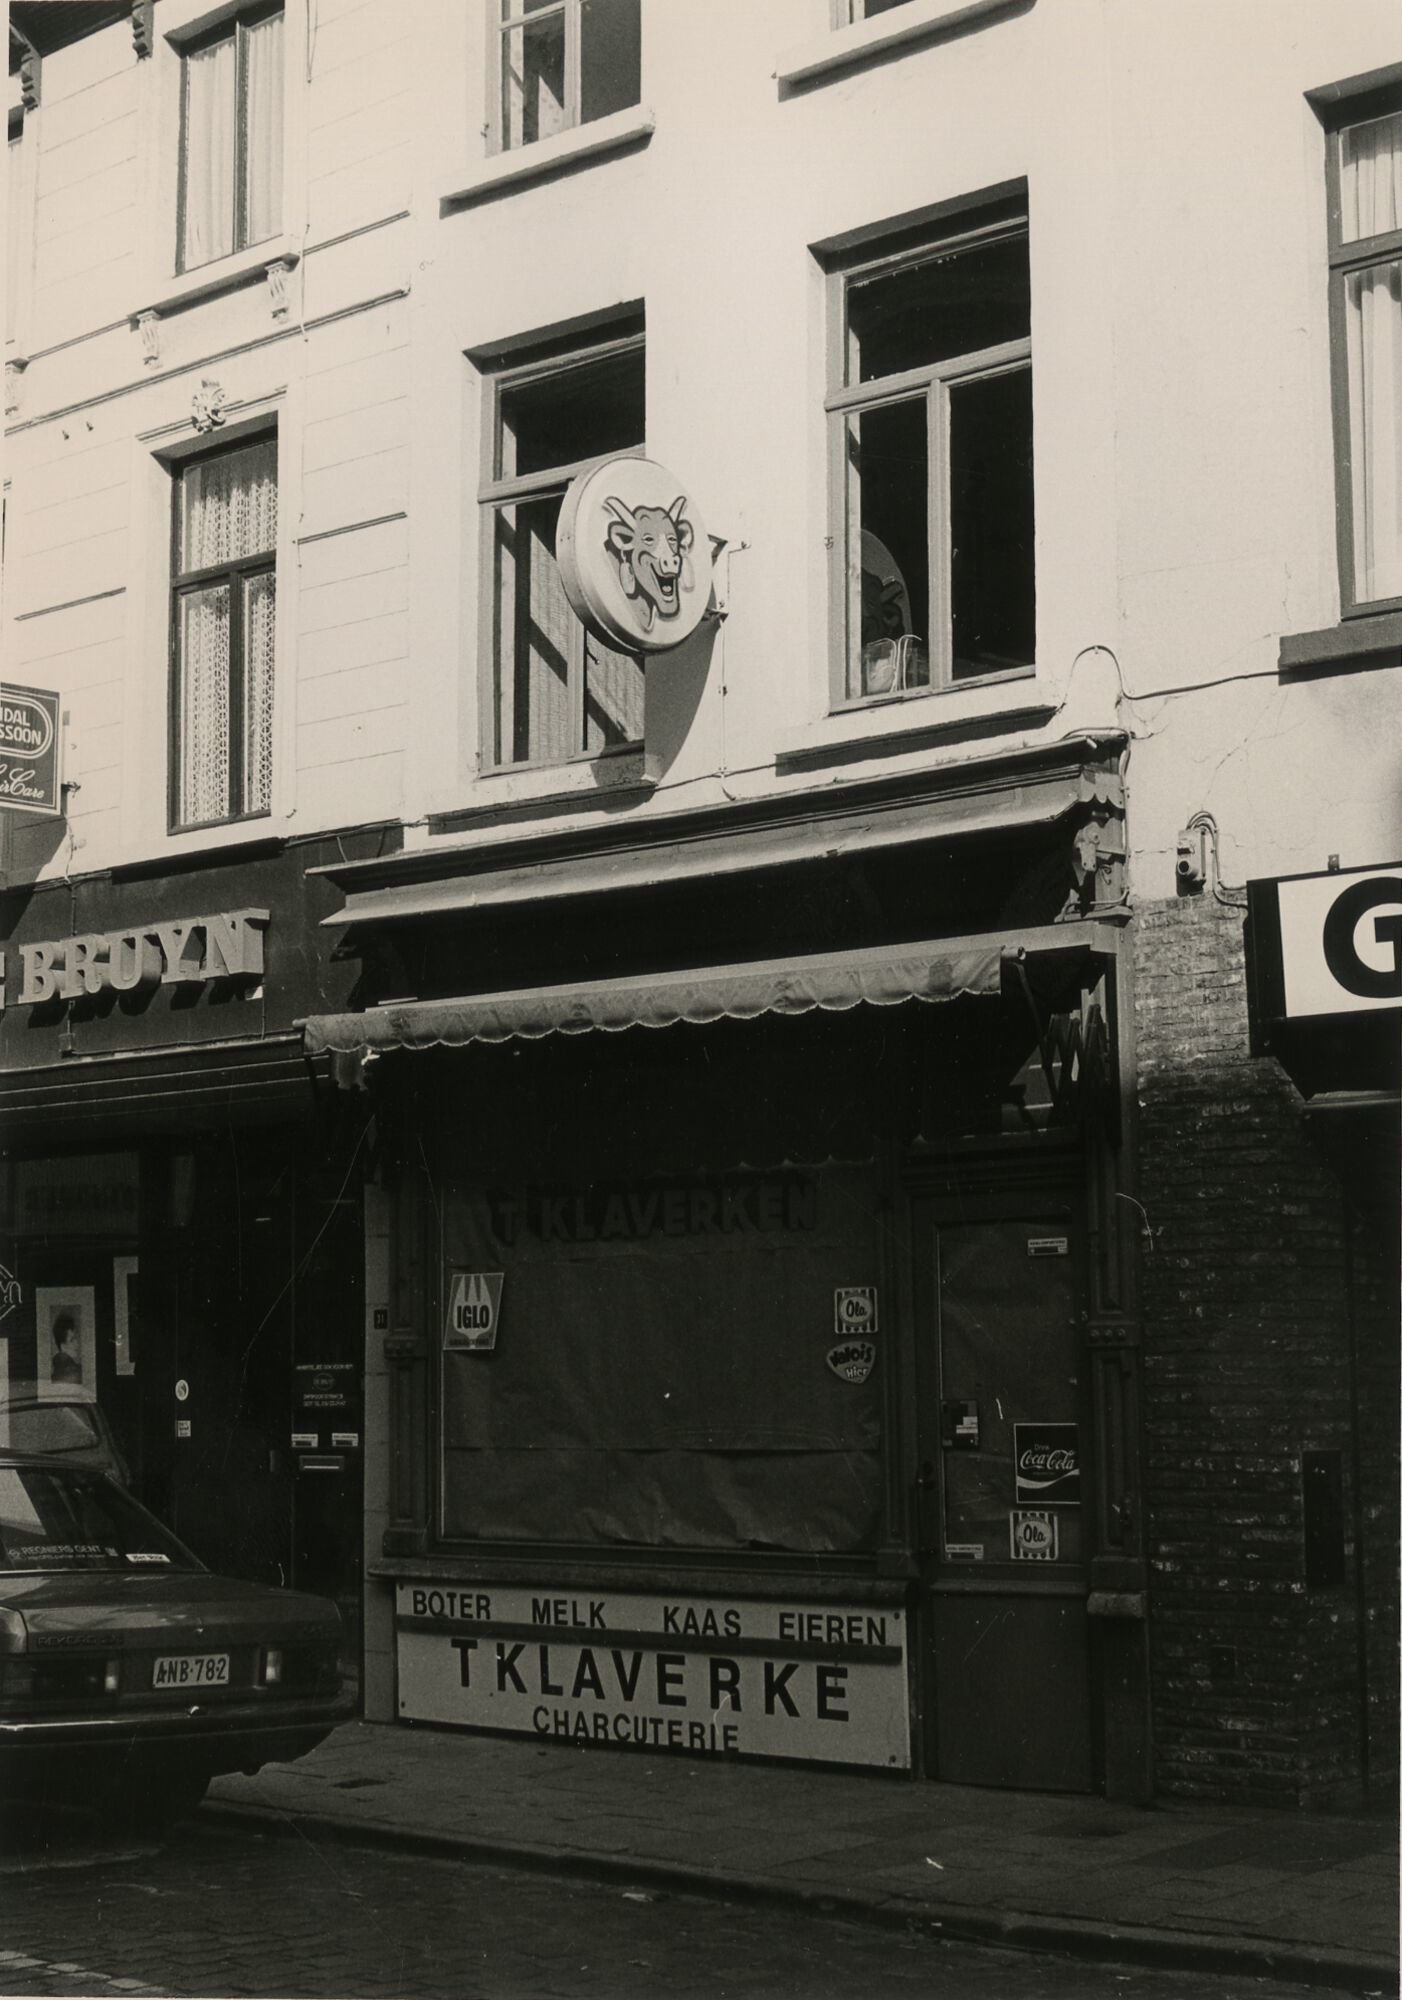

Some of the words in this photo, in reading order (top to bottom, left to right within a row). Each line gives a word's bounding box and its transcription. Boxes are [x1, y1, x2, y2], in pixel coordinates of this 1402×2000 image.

[18, 907, 270, 1004] BRUYN
[457, 1305, 490, 1329] IGLO
[846, 1300, 868, 1318] Ola
[1023, 1524, 1046, 1543] Ola
[412, 1590, 491, 1620] BOTER
[531, 1598, 606, 1629] MELK
[663, 1606, 741, 1637] KAAS
[779, 1612, 886, 1645] EIEREN
[532, 1705, 739, 1751] CHARCUTERIE
